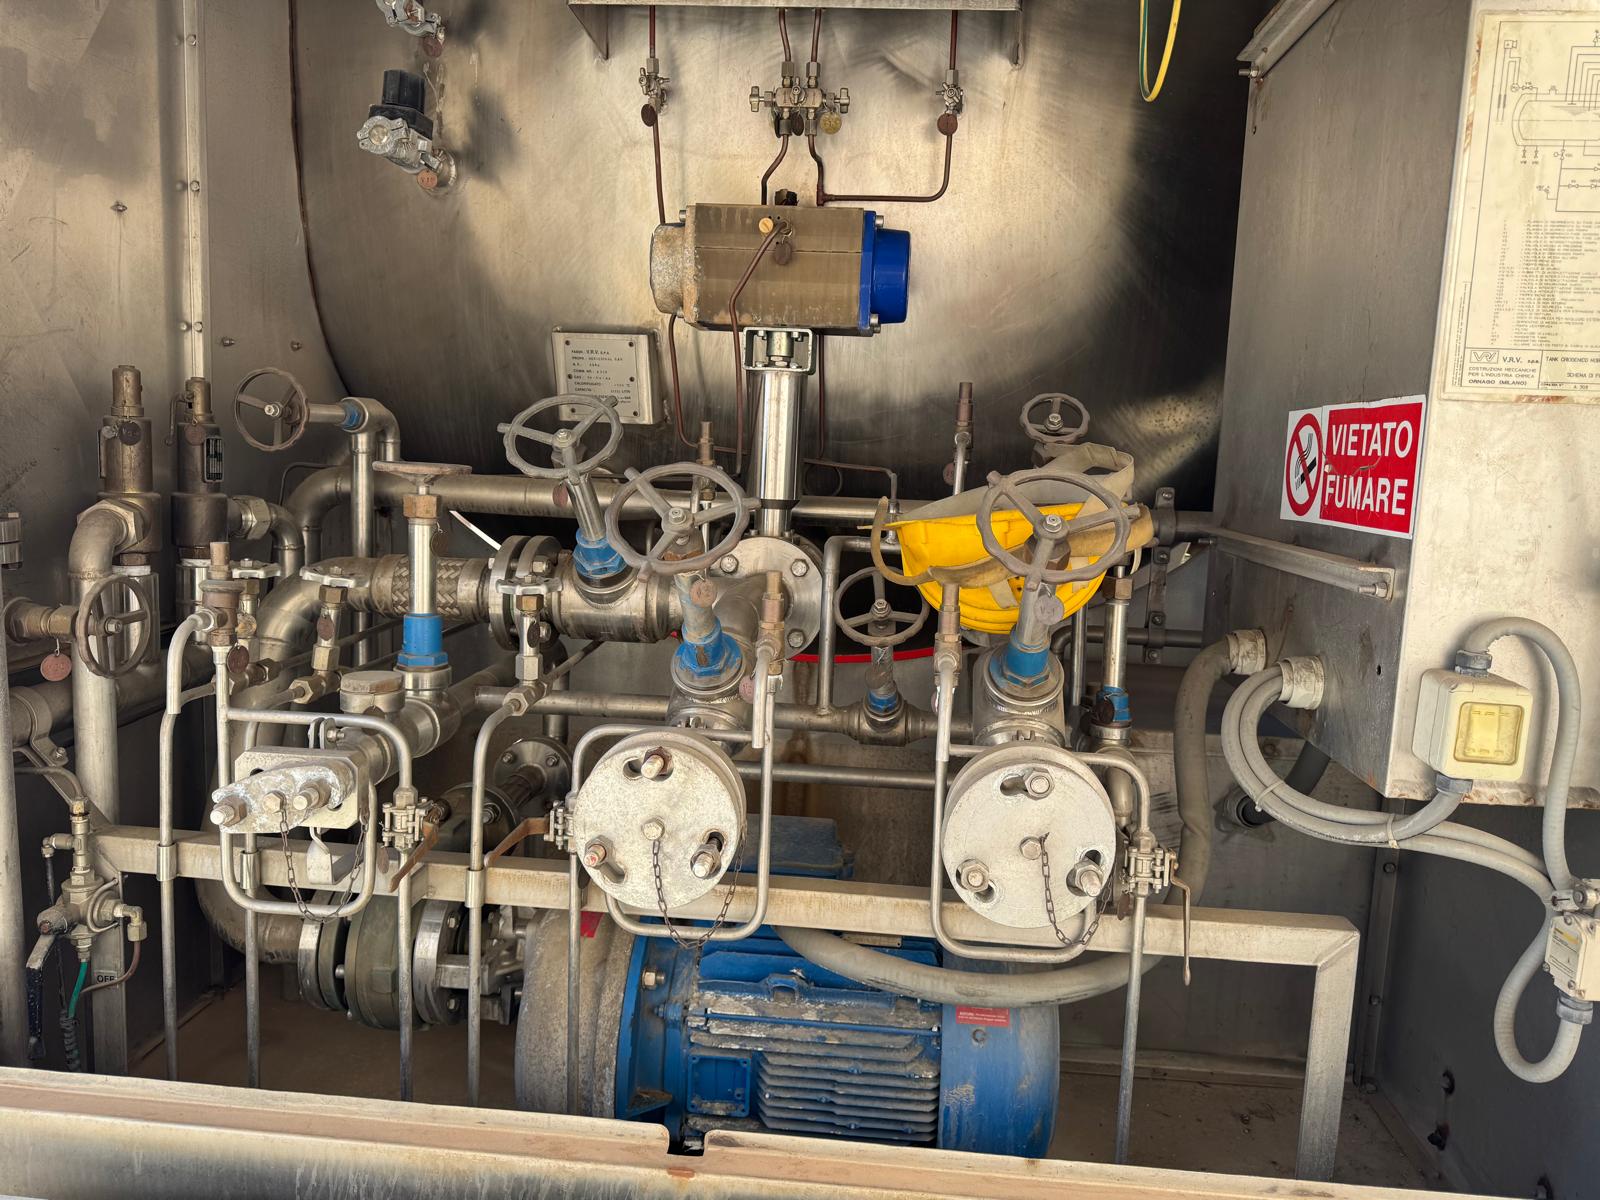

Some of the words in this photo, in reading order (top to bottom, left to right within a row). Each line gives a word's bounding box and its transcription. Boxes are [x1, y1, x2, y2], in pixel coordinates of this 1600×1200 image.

[1502, 356, 1523, 364] V.R.V.
[1332, 420, 1413, 458] VIETATO
[1324, 474, 1409, 516] FUMARE
